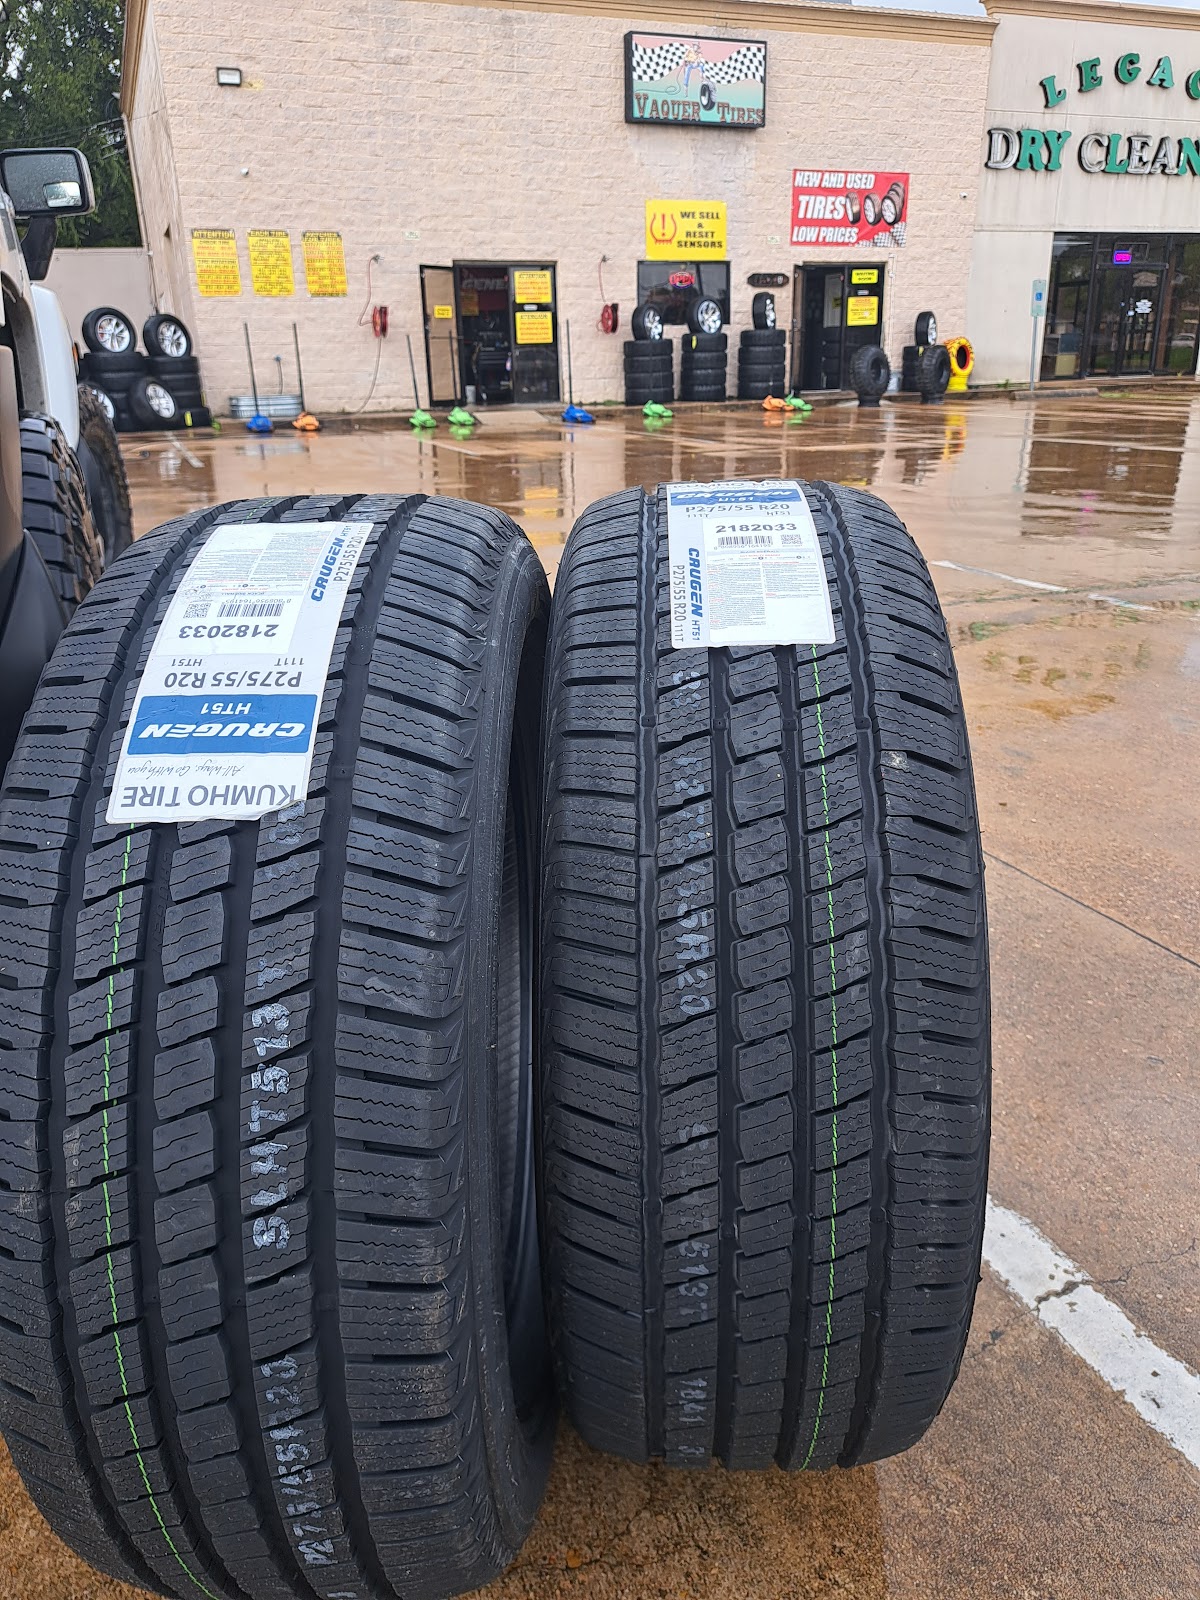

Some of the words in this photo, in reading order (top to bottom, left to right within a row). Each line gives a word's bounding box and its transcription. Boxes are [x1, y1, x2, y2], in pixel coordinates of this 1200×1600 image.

[716, 102, 764, 125] TIRES
[985, 127, 1072, 172] DRY
[794, 171, 821, 188] NEW
[821, 172, 846, 189] AND
[846, 173, 876, 189] USED
[680, 211, 696, 219] WE
[699, 211, 721, 220] SELL
[798, 194, 847, 220] TIRES
[193, 230, 235, 239] ATTENTION
[685, 231, 716, 239] RESET
[792, 226, 820, 243] LOW
[819, 226, 859, 244] PRICES
[677, 240, 723, 249] SENSORS
[685, 505, 754, 513] P275/55
[759, 503, 790, 511] R20
[715, 523, 797, 534] 2182033
[310, 536, 345, 602] CRUGEN
[340, 525, 353, 537] HT51
[333, 549, 357, 582] P275/55
[347, 535, 364, 549] R20
[673, 564, 686, 602] P275/55
[688, 547, 703, 618] CRUGEN
[674, 602, 687, 623] R20
[178, 623, 279, 639] 2182033
[674, 624, 684, 643] 111T
[691, 619, 701, 642] HT51
[170, 658, 203, 667] HT51
[273, 657, 305, 667] 111T
[163, 671, 206, 688] R20
[210, 671, 303, 688] P275/55
[199, 702, 252, 715] HT51
[138, 722, 306, 738] CRUGEN
[127, 760, 150, 774] you
[175, 765, 191, 776] Go
[120, 784, 181, 808] TIRE
[187, 784, 297, 808] KUMHO
